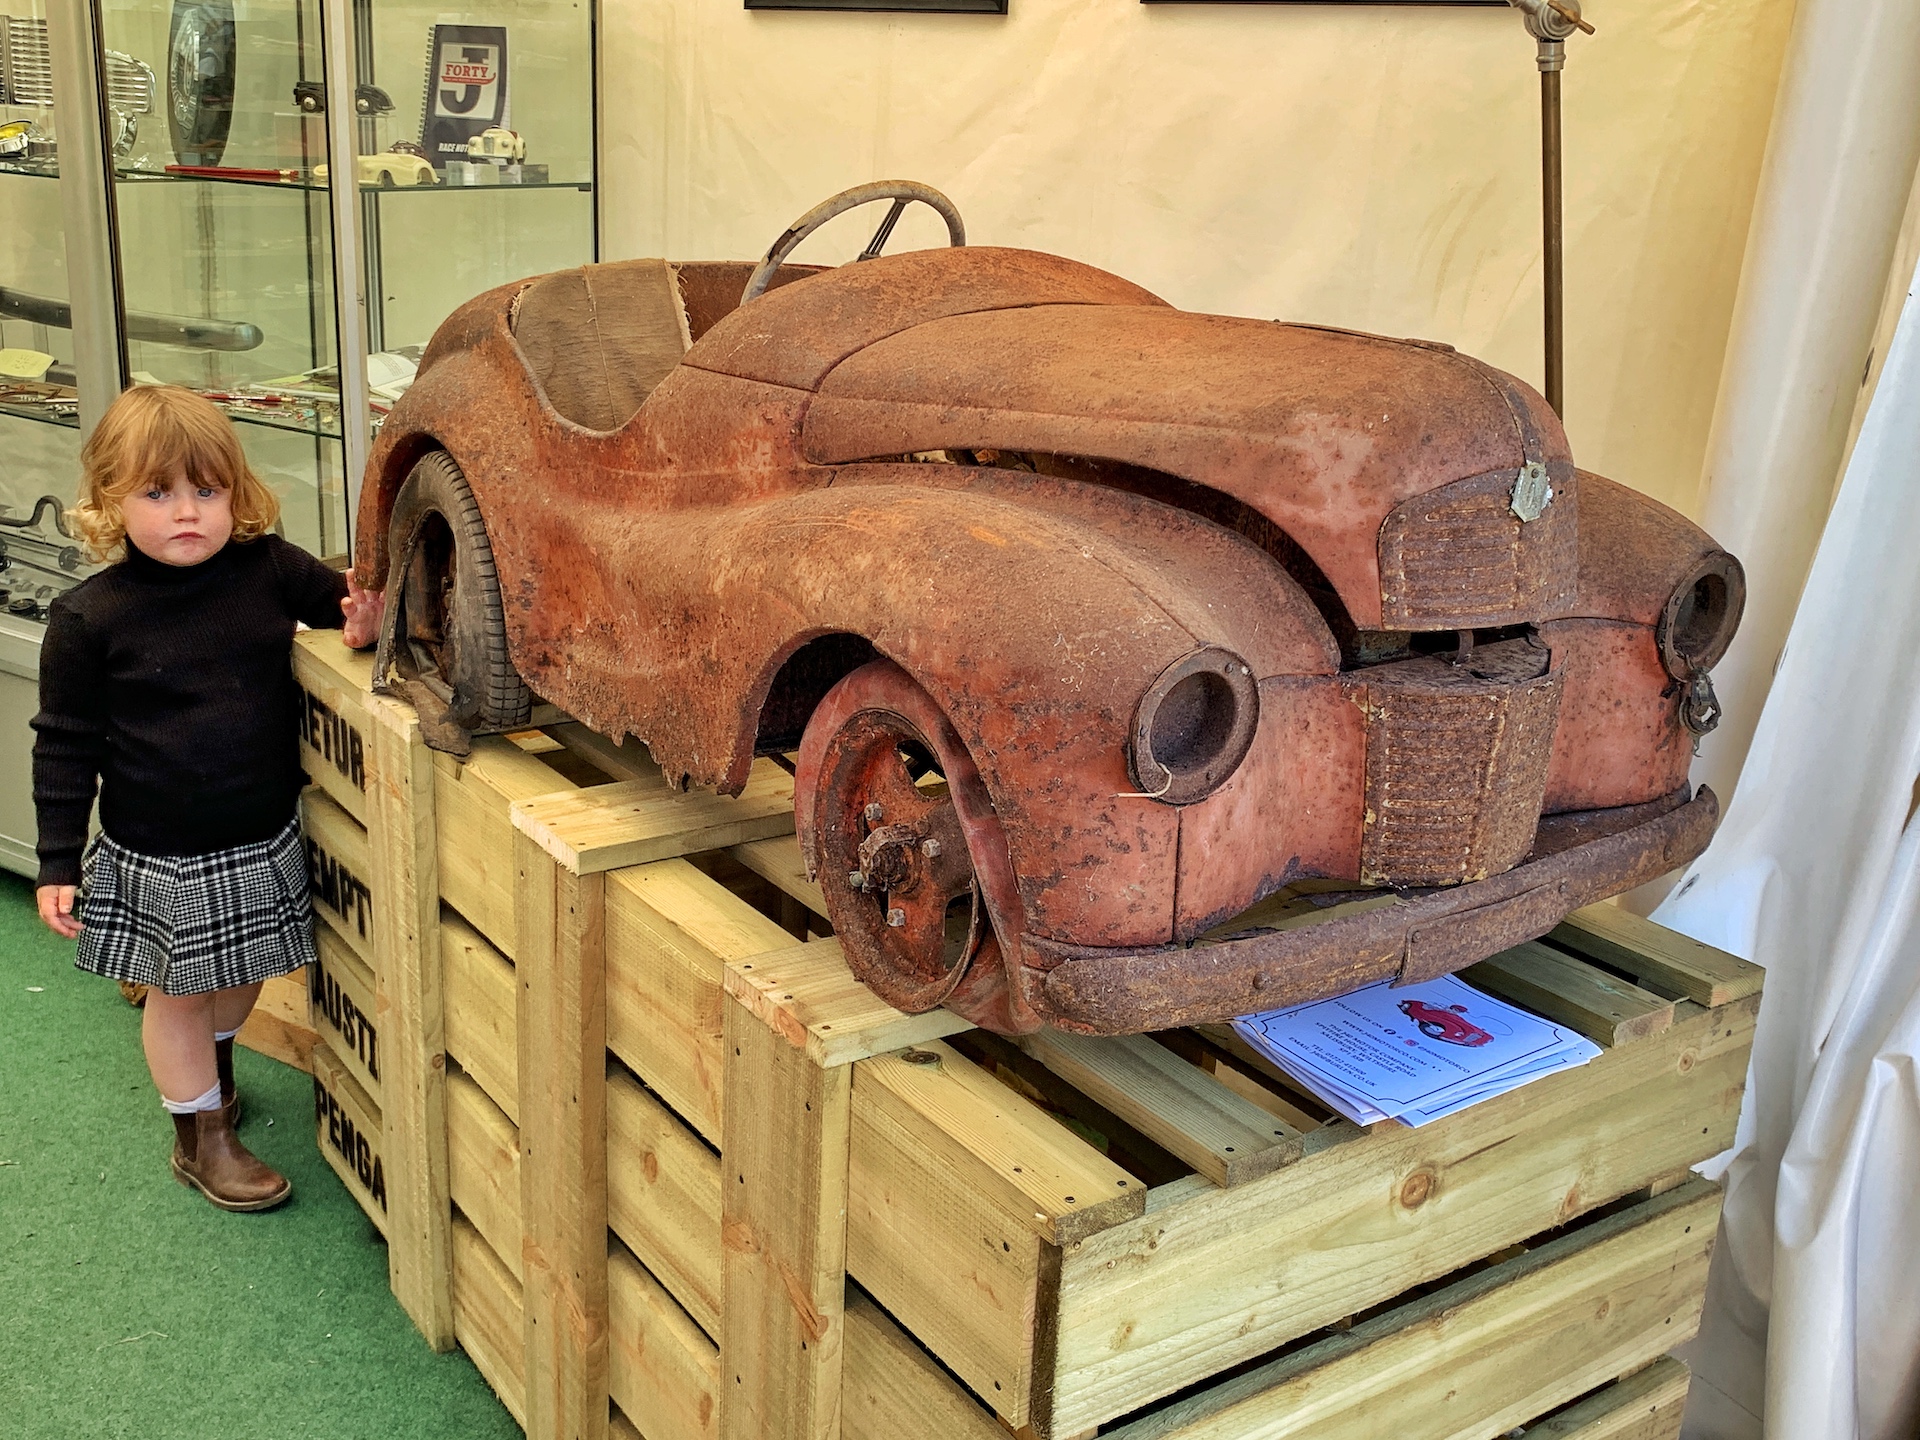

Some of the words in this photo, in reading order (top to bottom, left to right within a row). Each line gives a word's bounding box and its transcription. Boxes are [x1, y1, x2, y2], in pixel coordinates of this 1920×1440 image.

[445, 64, 489, 78] FORTY
[438, 143, 455, 152] RACE
[455, 144, 469, 153] NOT
[307, 836, 371, 941] EMPT
[1333, 1001, 1363, 1018] FOLLOW
[1371, 1021, 1385, 1029] ON
[1353, 1037, 1380, 1054] MOTOR
[1379, 1051, 1416, 1071] COMPANY
[1369, 1052, 1396, 1067] CASTLE
[1394, 1064, 1417, 1078] ROAD
[314, 1073, 387, 1214] PENGA
